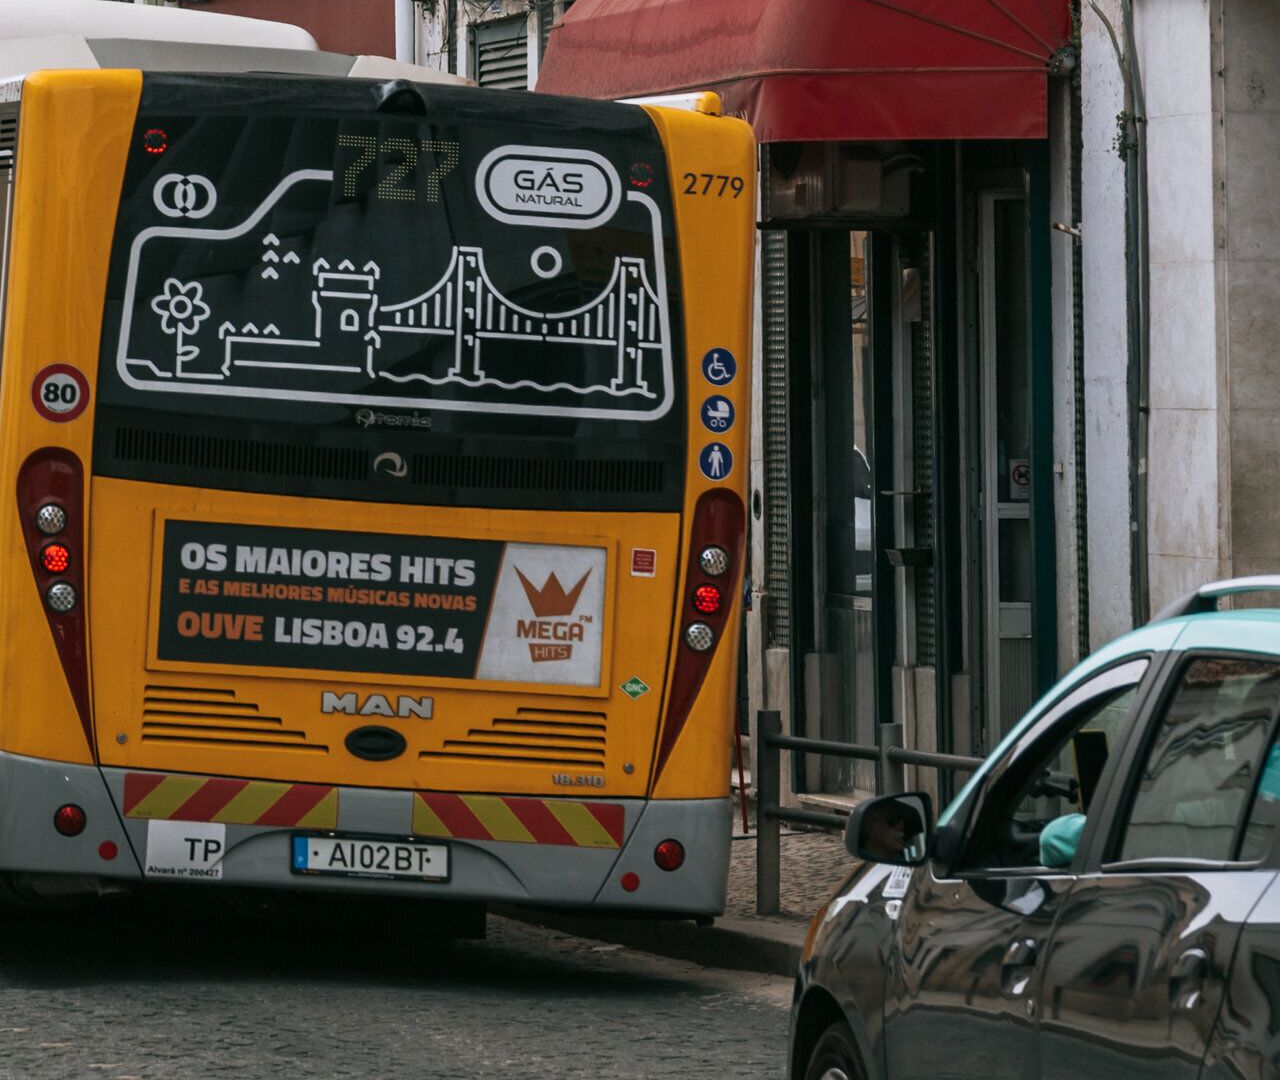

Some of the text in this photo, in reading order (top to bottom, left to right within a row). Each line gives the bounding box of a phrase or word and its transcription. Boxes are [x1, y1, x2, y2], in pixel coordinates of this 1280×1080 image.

[339, 134, 461, 204] 727
[513, 167, 585, 194] GÁS
[682, 172, 745, 200] 2779
[515, 194, 583, 208] NATURAL
[43, 382, 77, 404] 80
[180, 542, 476, 587] OS MAIORES HITS
[179, 578, 478, 612] E AS MELHORES MÚSICAS NOVAS
[579, 614, 593, 624] FM
[177, 611, 464, 654] OUVE LISBOA 92.4
[516, 620, 584, 642] MEGA
[534, 646, 568, 659] HITS
[625, 683, 644, 693] GNC
[321, 691, 434, 719] MAN
[552, 773, 605, 788] 18.310
[184, 837, 222, 862] TP
[147, 865, 175, 875] Alvará
[189, 868, 220, 877] 200427
